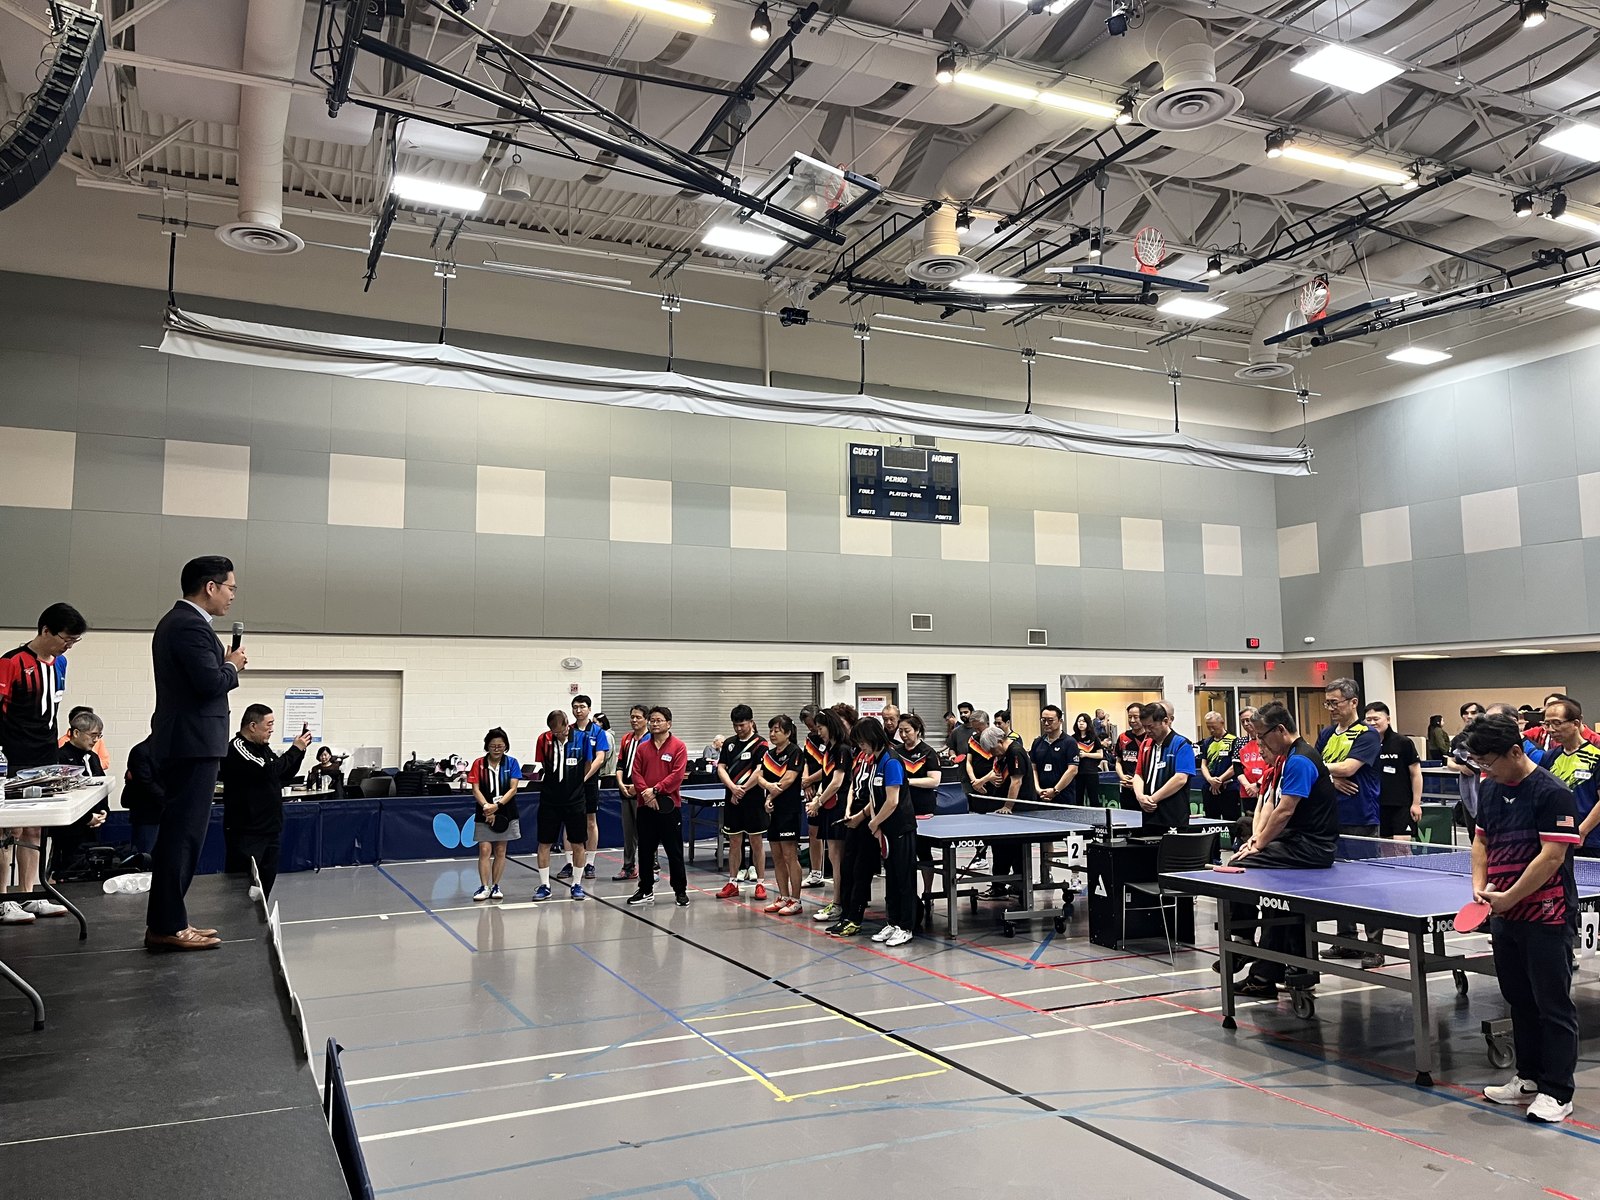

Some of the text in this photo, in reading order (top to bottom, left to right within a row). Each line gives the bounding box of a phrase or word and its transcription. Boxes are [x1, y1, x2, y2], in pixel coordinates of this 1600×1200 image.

[852, 447, 954, 464] GUEST HOME
[1207, 826, 1230, 834] JOOLA
[956, 839, 985, 848] JOOLA
[1071, 842, 1079, 860] 2
[1259, 895, 1291, 912] JOOLA
[1427, 916, 1434, 933] 3
[1436, 920, 1454, 933] JOO
[1586, 923, 1595, 950] 3
